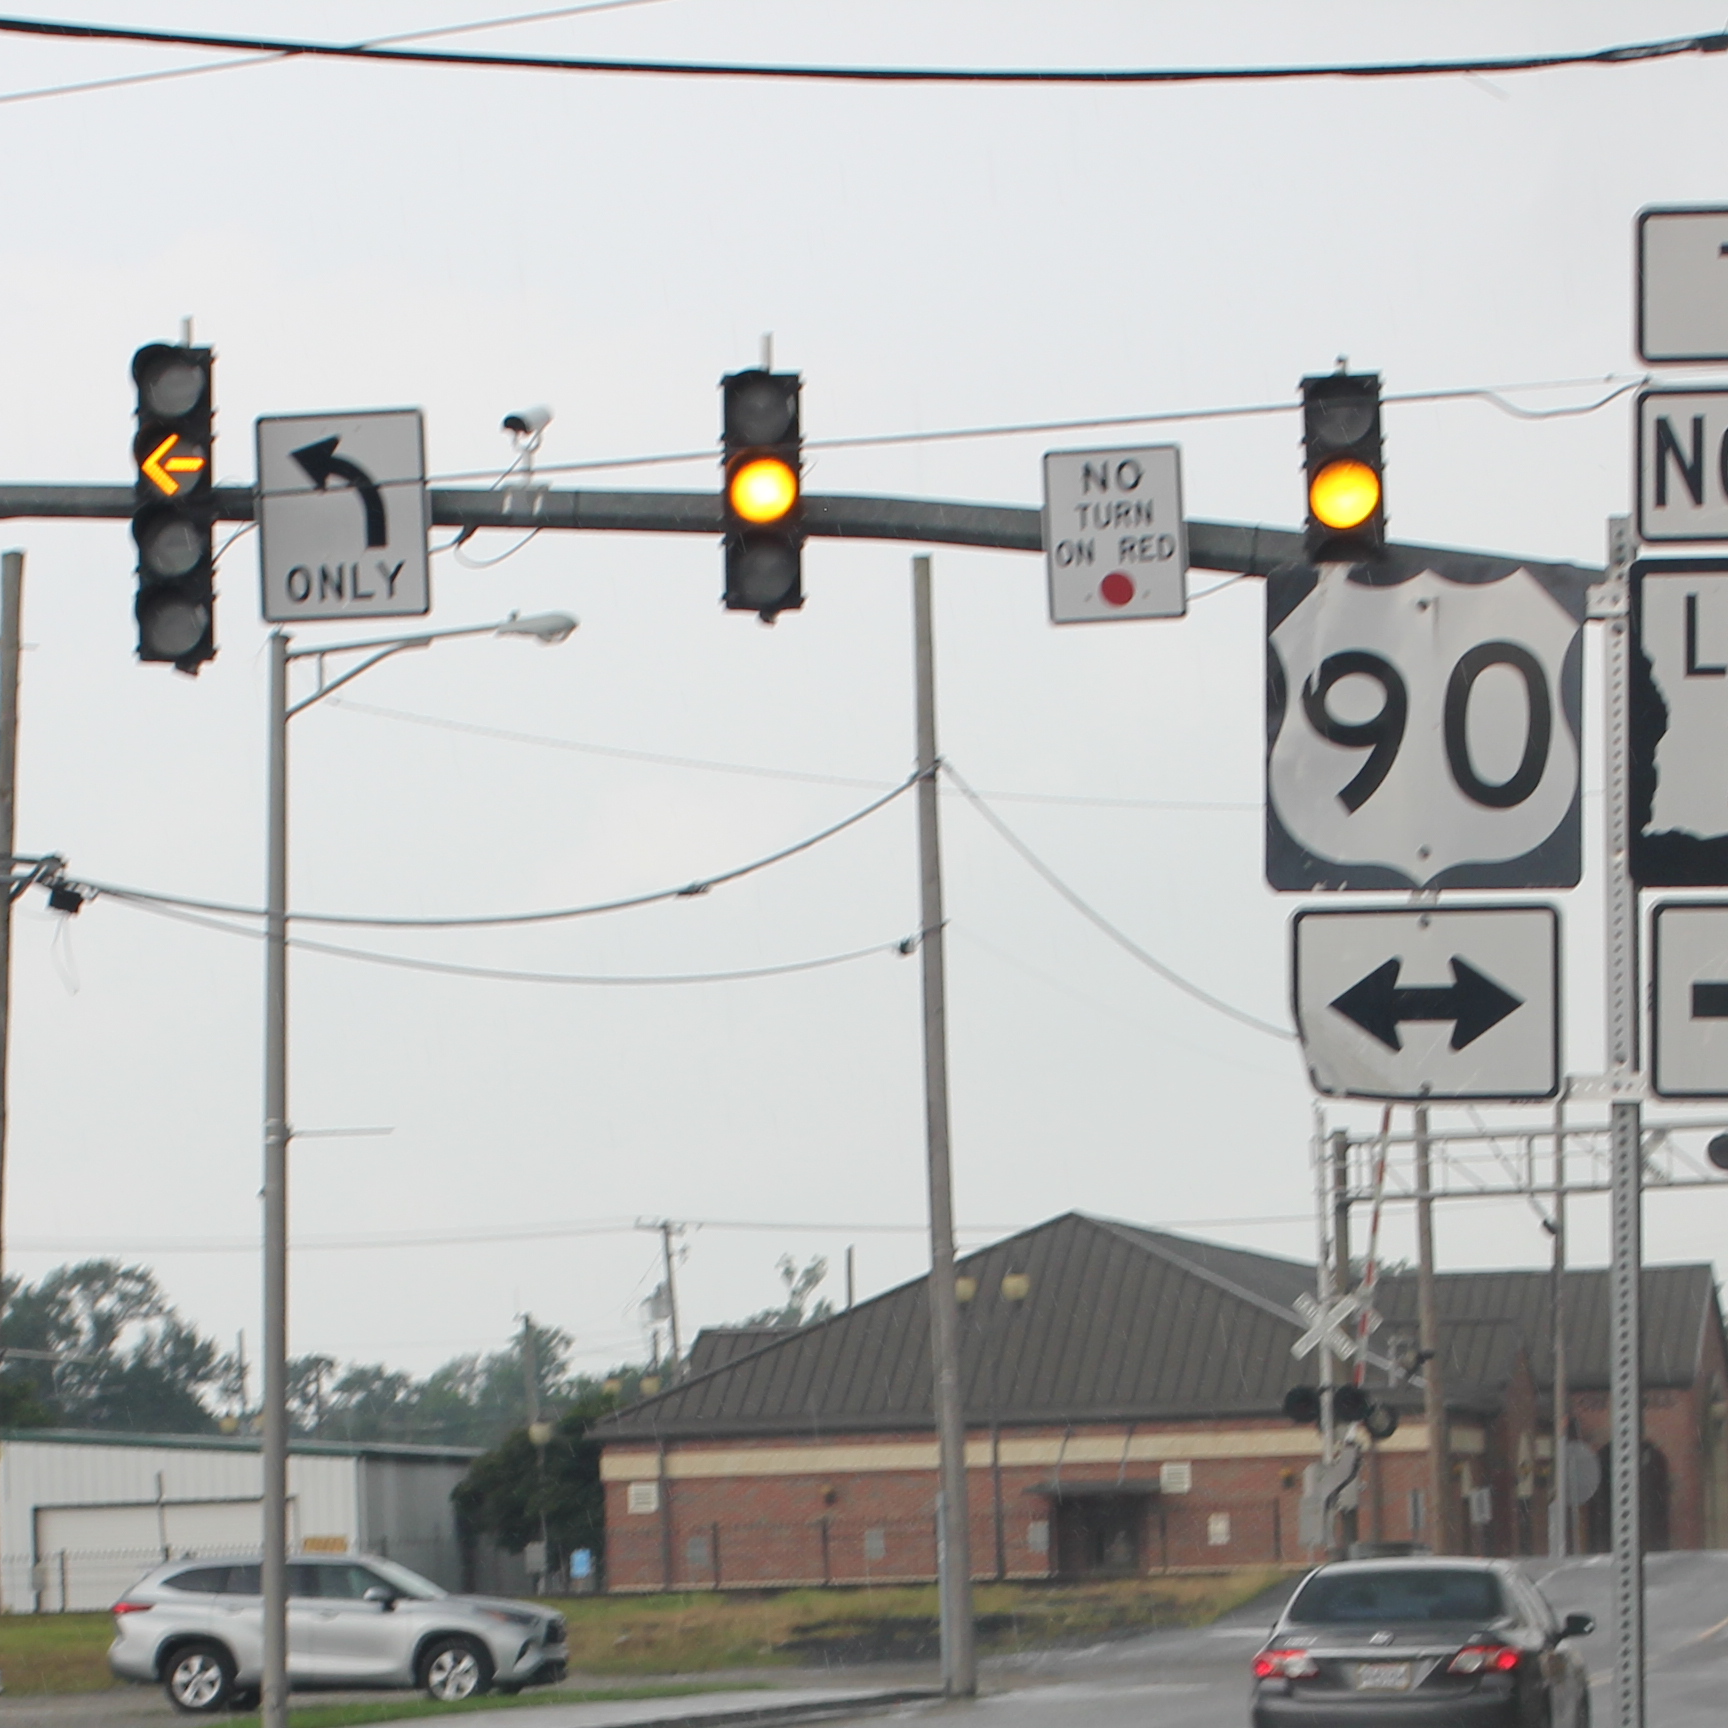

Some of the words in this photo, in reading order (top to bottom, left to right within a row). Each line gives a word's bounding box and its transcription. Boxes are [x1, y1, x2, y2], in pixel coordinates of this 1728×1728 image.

[1081, 458, 1143, 495] NO
[1075, 498, 1154, 531] TURN
[1054, 537, 1095, 569] ON
[1118, 533, 1176, 564] RED
[285, 559, 405, 604] ONLY
[1300, 639, 1553, 817] 90
